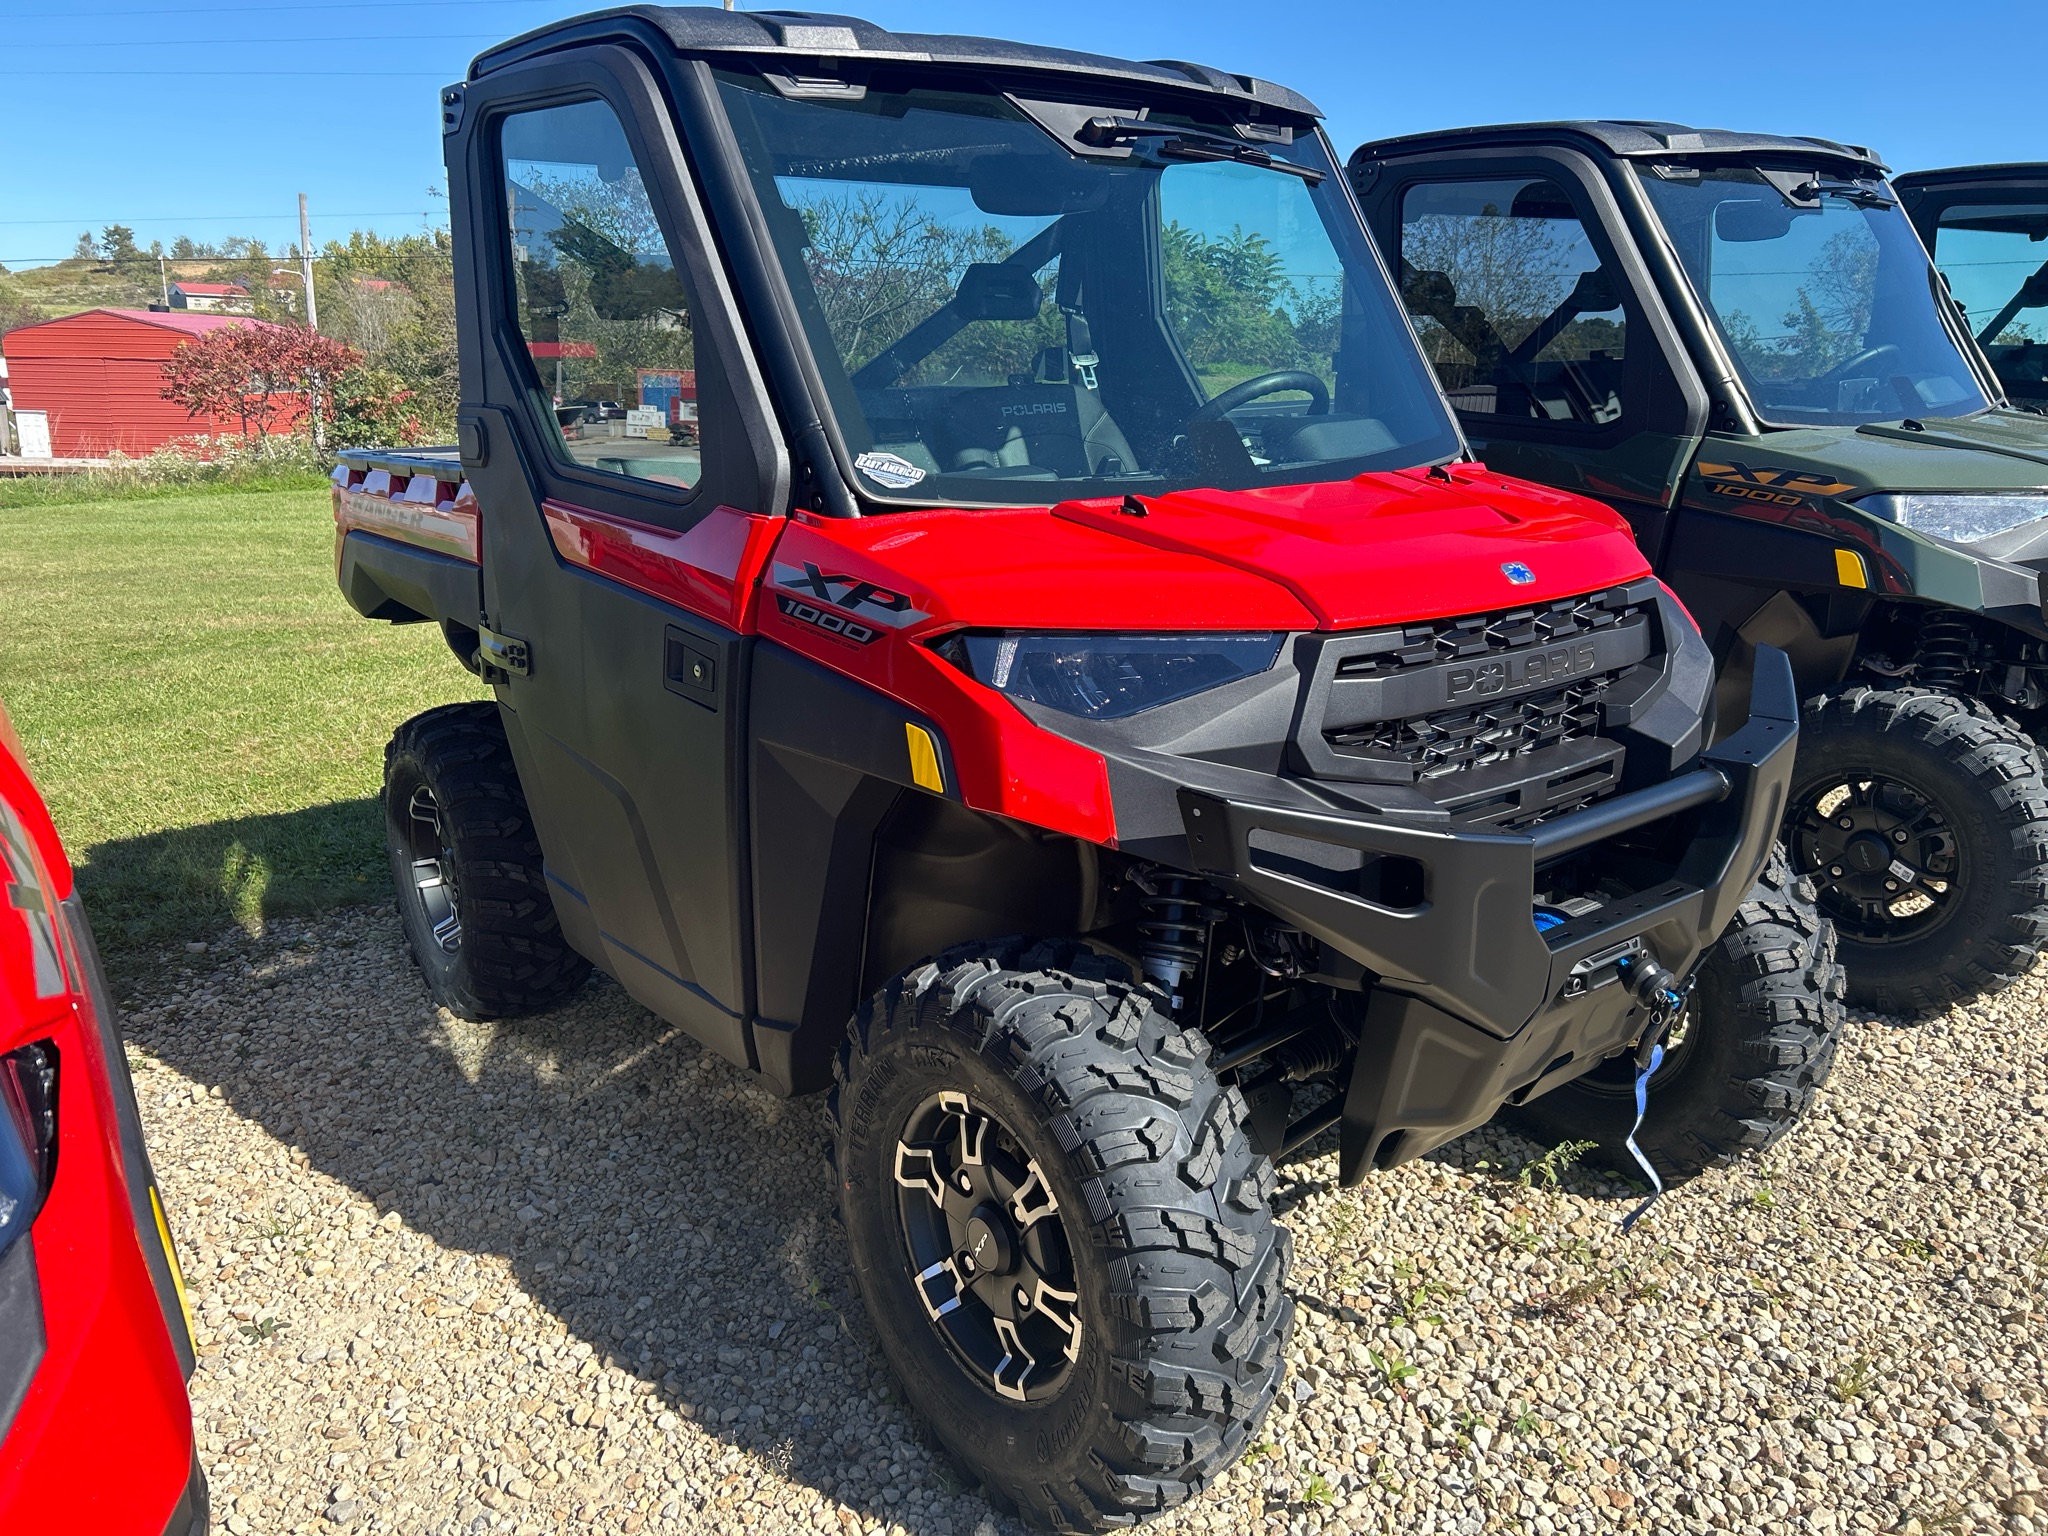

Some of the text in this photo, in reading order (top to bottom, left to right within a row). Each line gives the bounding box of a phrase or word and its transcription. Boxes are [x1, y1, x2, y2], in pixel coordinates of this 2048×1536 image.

[1001, 402, 1067, 417] POLARIS
[859, 457, 881, 470] EAST
[880, 462, 922, 480] AMERICAN
[1706, 460, 1839, 487] XP
[1713, 484, 1802, 506] 1000
[351, 497, 424, 528] RANGER
[776, 560, 913, 612] XP
[784, 600, 873, 642] 1000
[1447, 641, 1595, 702] POLARIS
[846, 1056, 899, 1190] X-TERRAIN
[974, 1233, 988, 1258] XP
